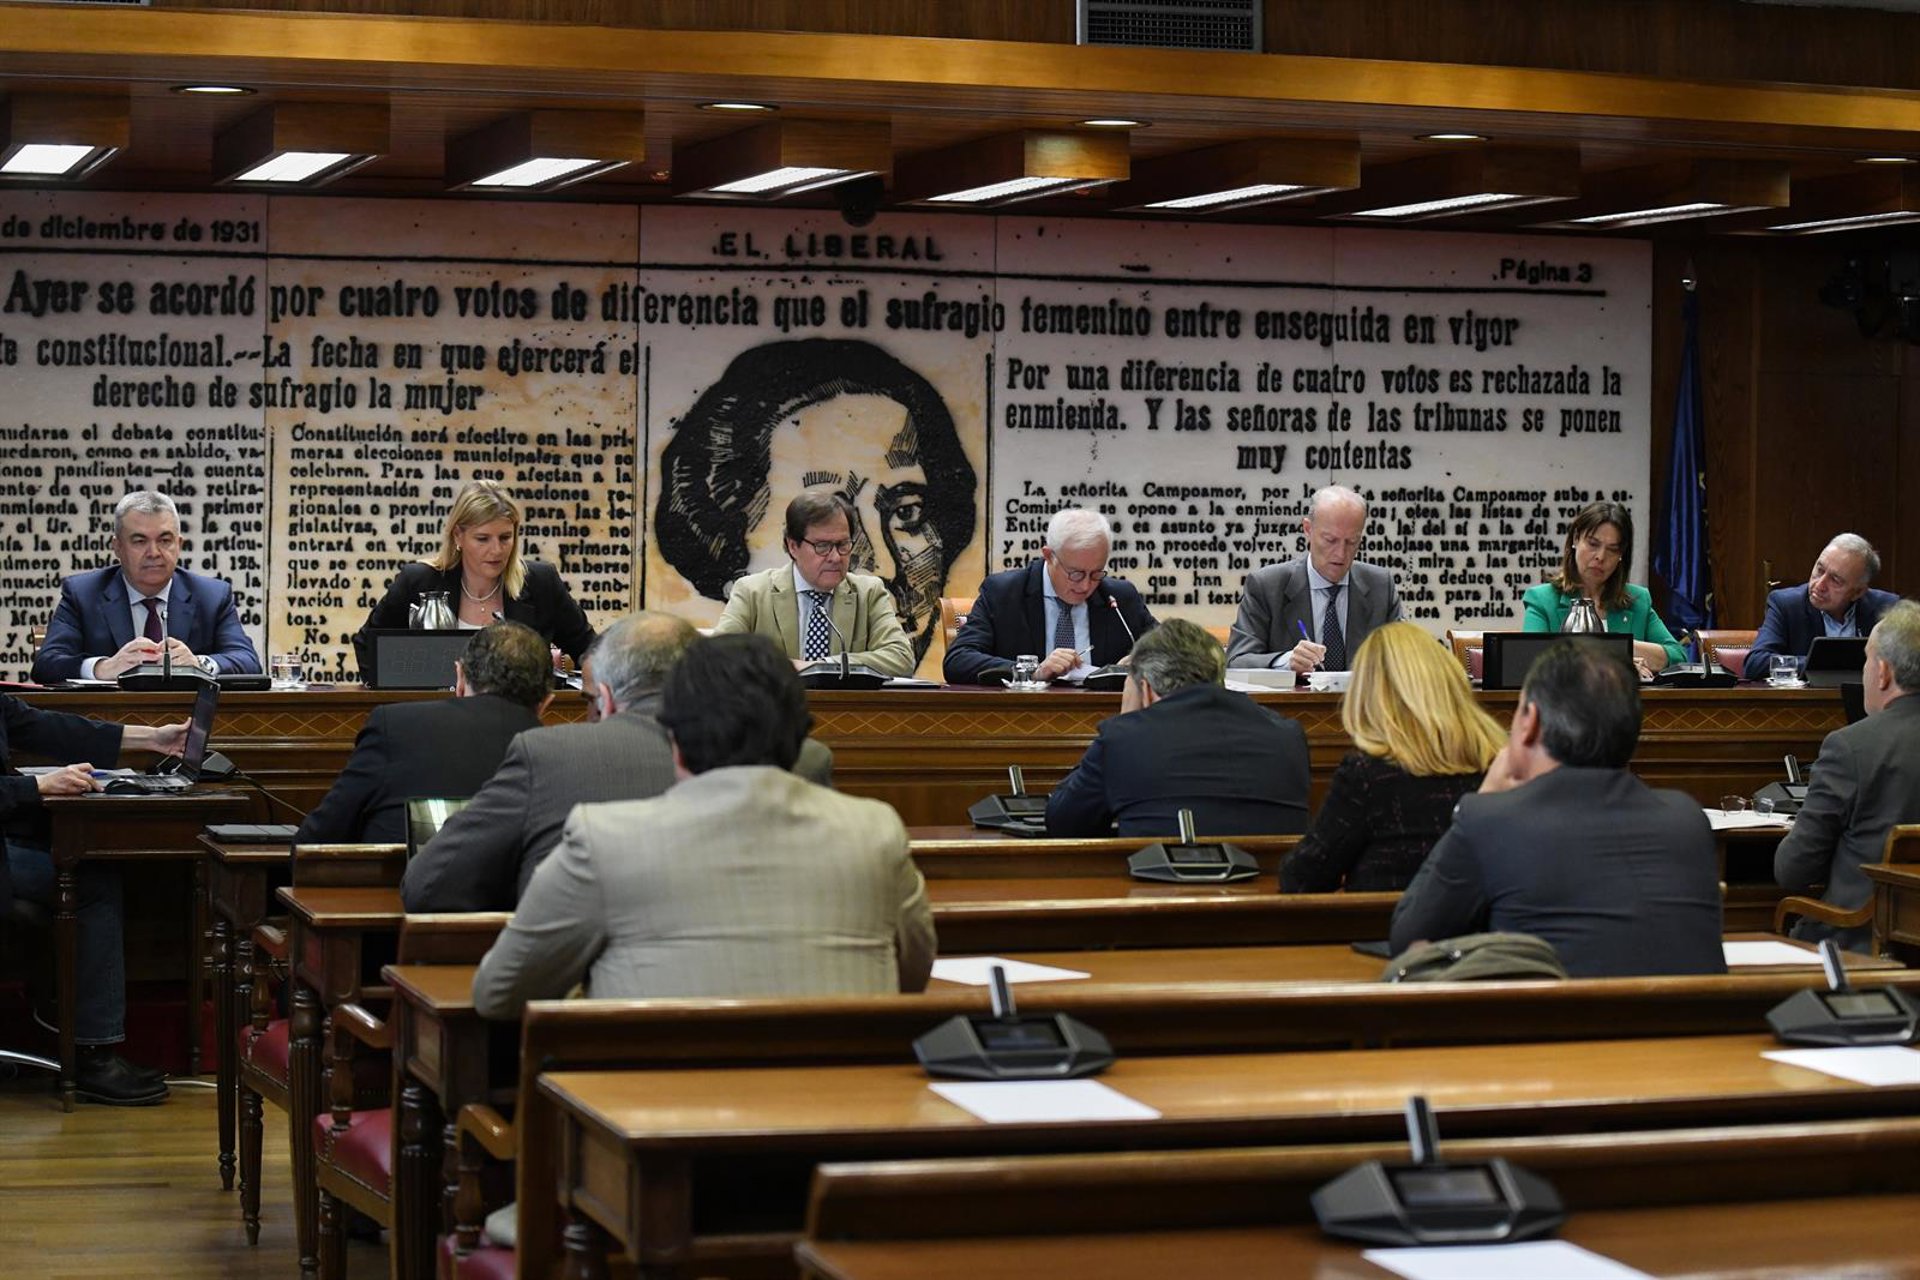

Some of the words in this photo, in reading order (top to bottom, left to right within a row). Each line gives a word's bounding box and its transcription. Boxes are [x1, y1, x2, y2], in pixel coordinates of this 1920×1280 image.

[2, 214, 32, 238] de
[40, 214, 166, 241] diciembre
[173, 217, 203, 242] de
[210, 220, 260, 243] 1931
[785, 233, 945, 261] LIBERAL
[1500, 258, 1571, 285] Página
[1575, 262, 1594, 283] 3
[3, 269, 90, 318] Ayer
[97, 281, 136, 315] se
[149, 275, 255, 317] acordó
[270, 285, 325, 323] por
[339, 279, 440, 318] cuatro
[454, 280, 540, 320] votos
[551, 282, 588, 322] de
[601, 282, 759, 328] diferencia
[774, 297, 826, 333] que
[840, 289, 870, 328] el
[885, 291, 1005, 339] sufragio
[1020, 296, 1152, 337] femenino
[1165, 302, 1242, 339] entre
[1255, 306, 1390, 349] enseguida
[1404, 314, 1436, 344] en
[1448, 309, 1521, 352] vigor
[311, 335, 380, 368] fecha
[394, 343, 423, 369] en
[441, 344, 487, 375] que
[497, 338, 607, 377] ejercerá
[619, 338, 639, 377] el
[93, 374, 196, 408] derecho
[209, 375, 238, 408] de
[249, 376, 357, 414] sufragio
[368, 377, 392, 408] la
[1007, 358, 1050, 390] Por
[1066, 365, 1110, 390] una
[1121, 360, 1241, 392] diferencia
[1257, 362, 1282, 392] de
[1293, 364, 1365, 393] cuatro
[1381, 364, 1441, 394] votos
[1449, 370, 1472, 393] es
[1482, 364, 1590, 395] rechazada
[1603, 365, 1621, 396] la
[1006, 397, 1127, 430] enmienda.
[1144, 398, 1164, 430] Y
[1174, 398, 1211, 431] las
[1227, 404, 1317, 433] señoras
[1328, 401, 1351, 432] de
[1368, 401, 1401, 432] las
[1414, 402, 1507, 432] tribunas
[1522, 408, 1544, 432] se
[1559, 409, 1622, 437] ponen
[1236, 445, 1287, 474] muy
[1306, 440, 1412, 470] contentas
